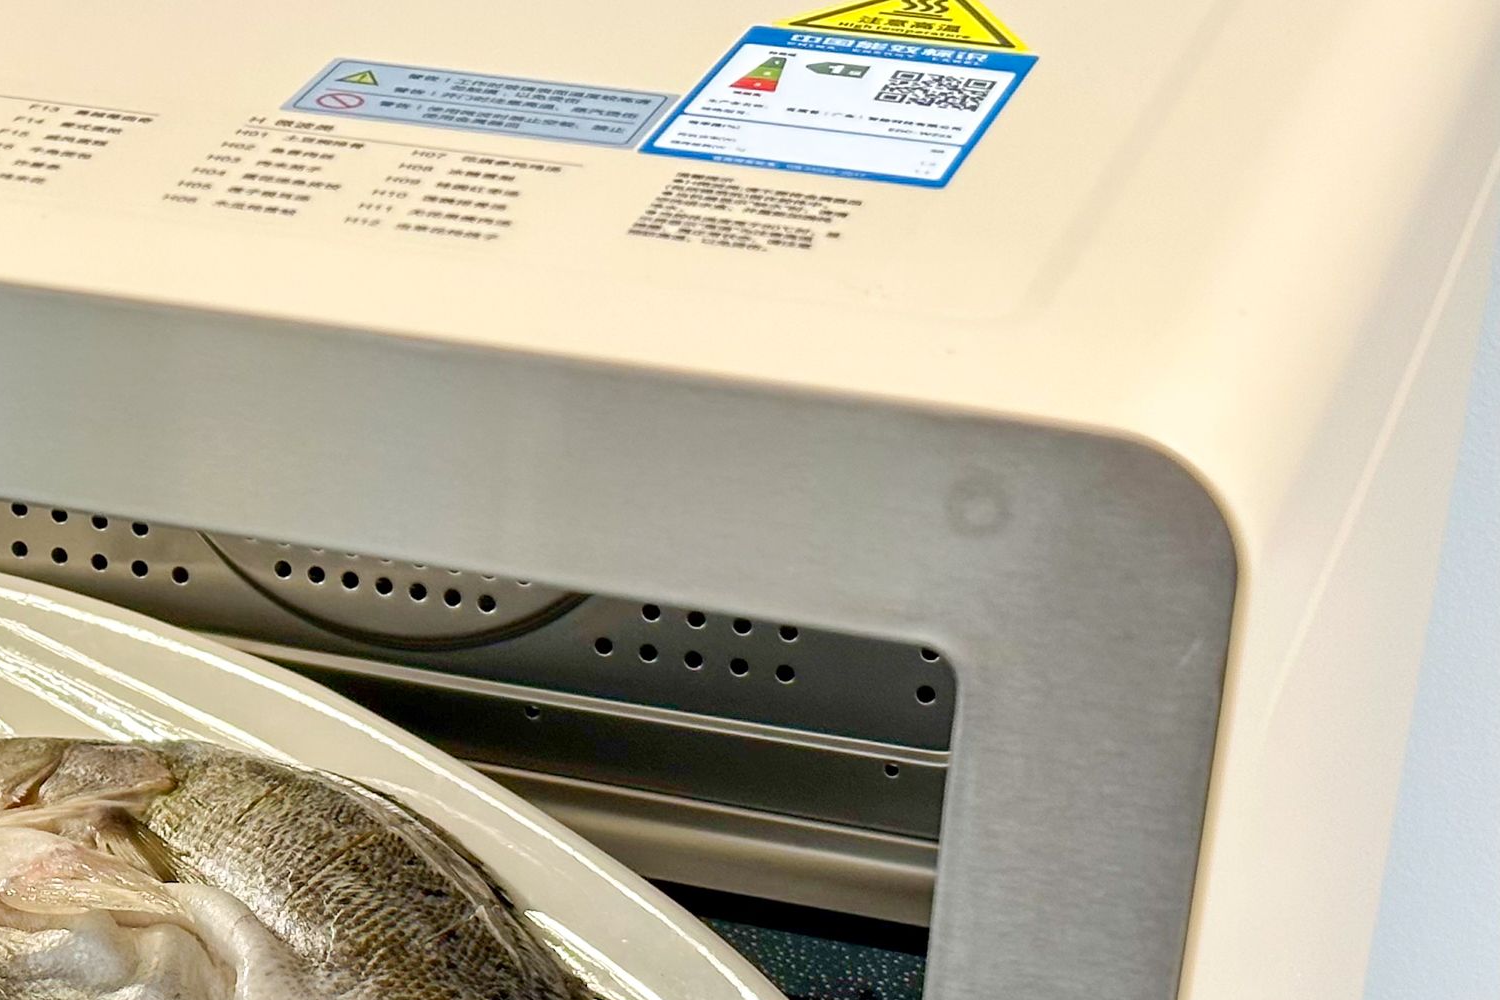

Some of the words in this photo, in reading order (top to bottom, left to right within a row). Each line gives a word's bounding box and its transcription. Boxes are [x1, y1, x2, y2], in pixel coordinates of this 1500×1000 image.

[859, 15, 962, 33] 注意高温
[838, 21, 873, 31] High
[876, 25, 971, 39] temperature
[789, 34, 989, 63] 中国能效标识
[13, 115, 45, 125] F14
[250, 116, 268, 124] H
[235, 129, 268, 138] H01
[411, 149, 448, 160] H07
